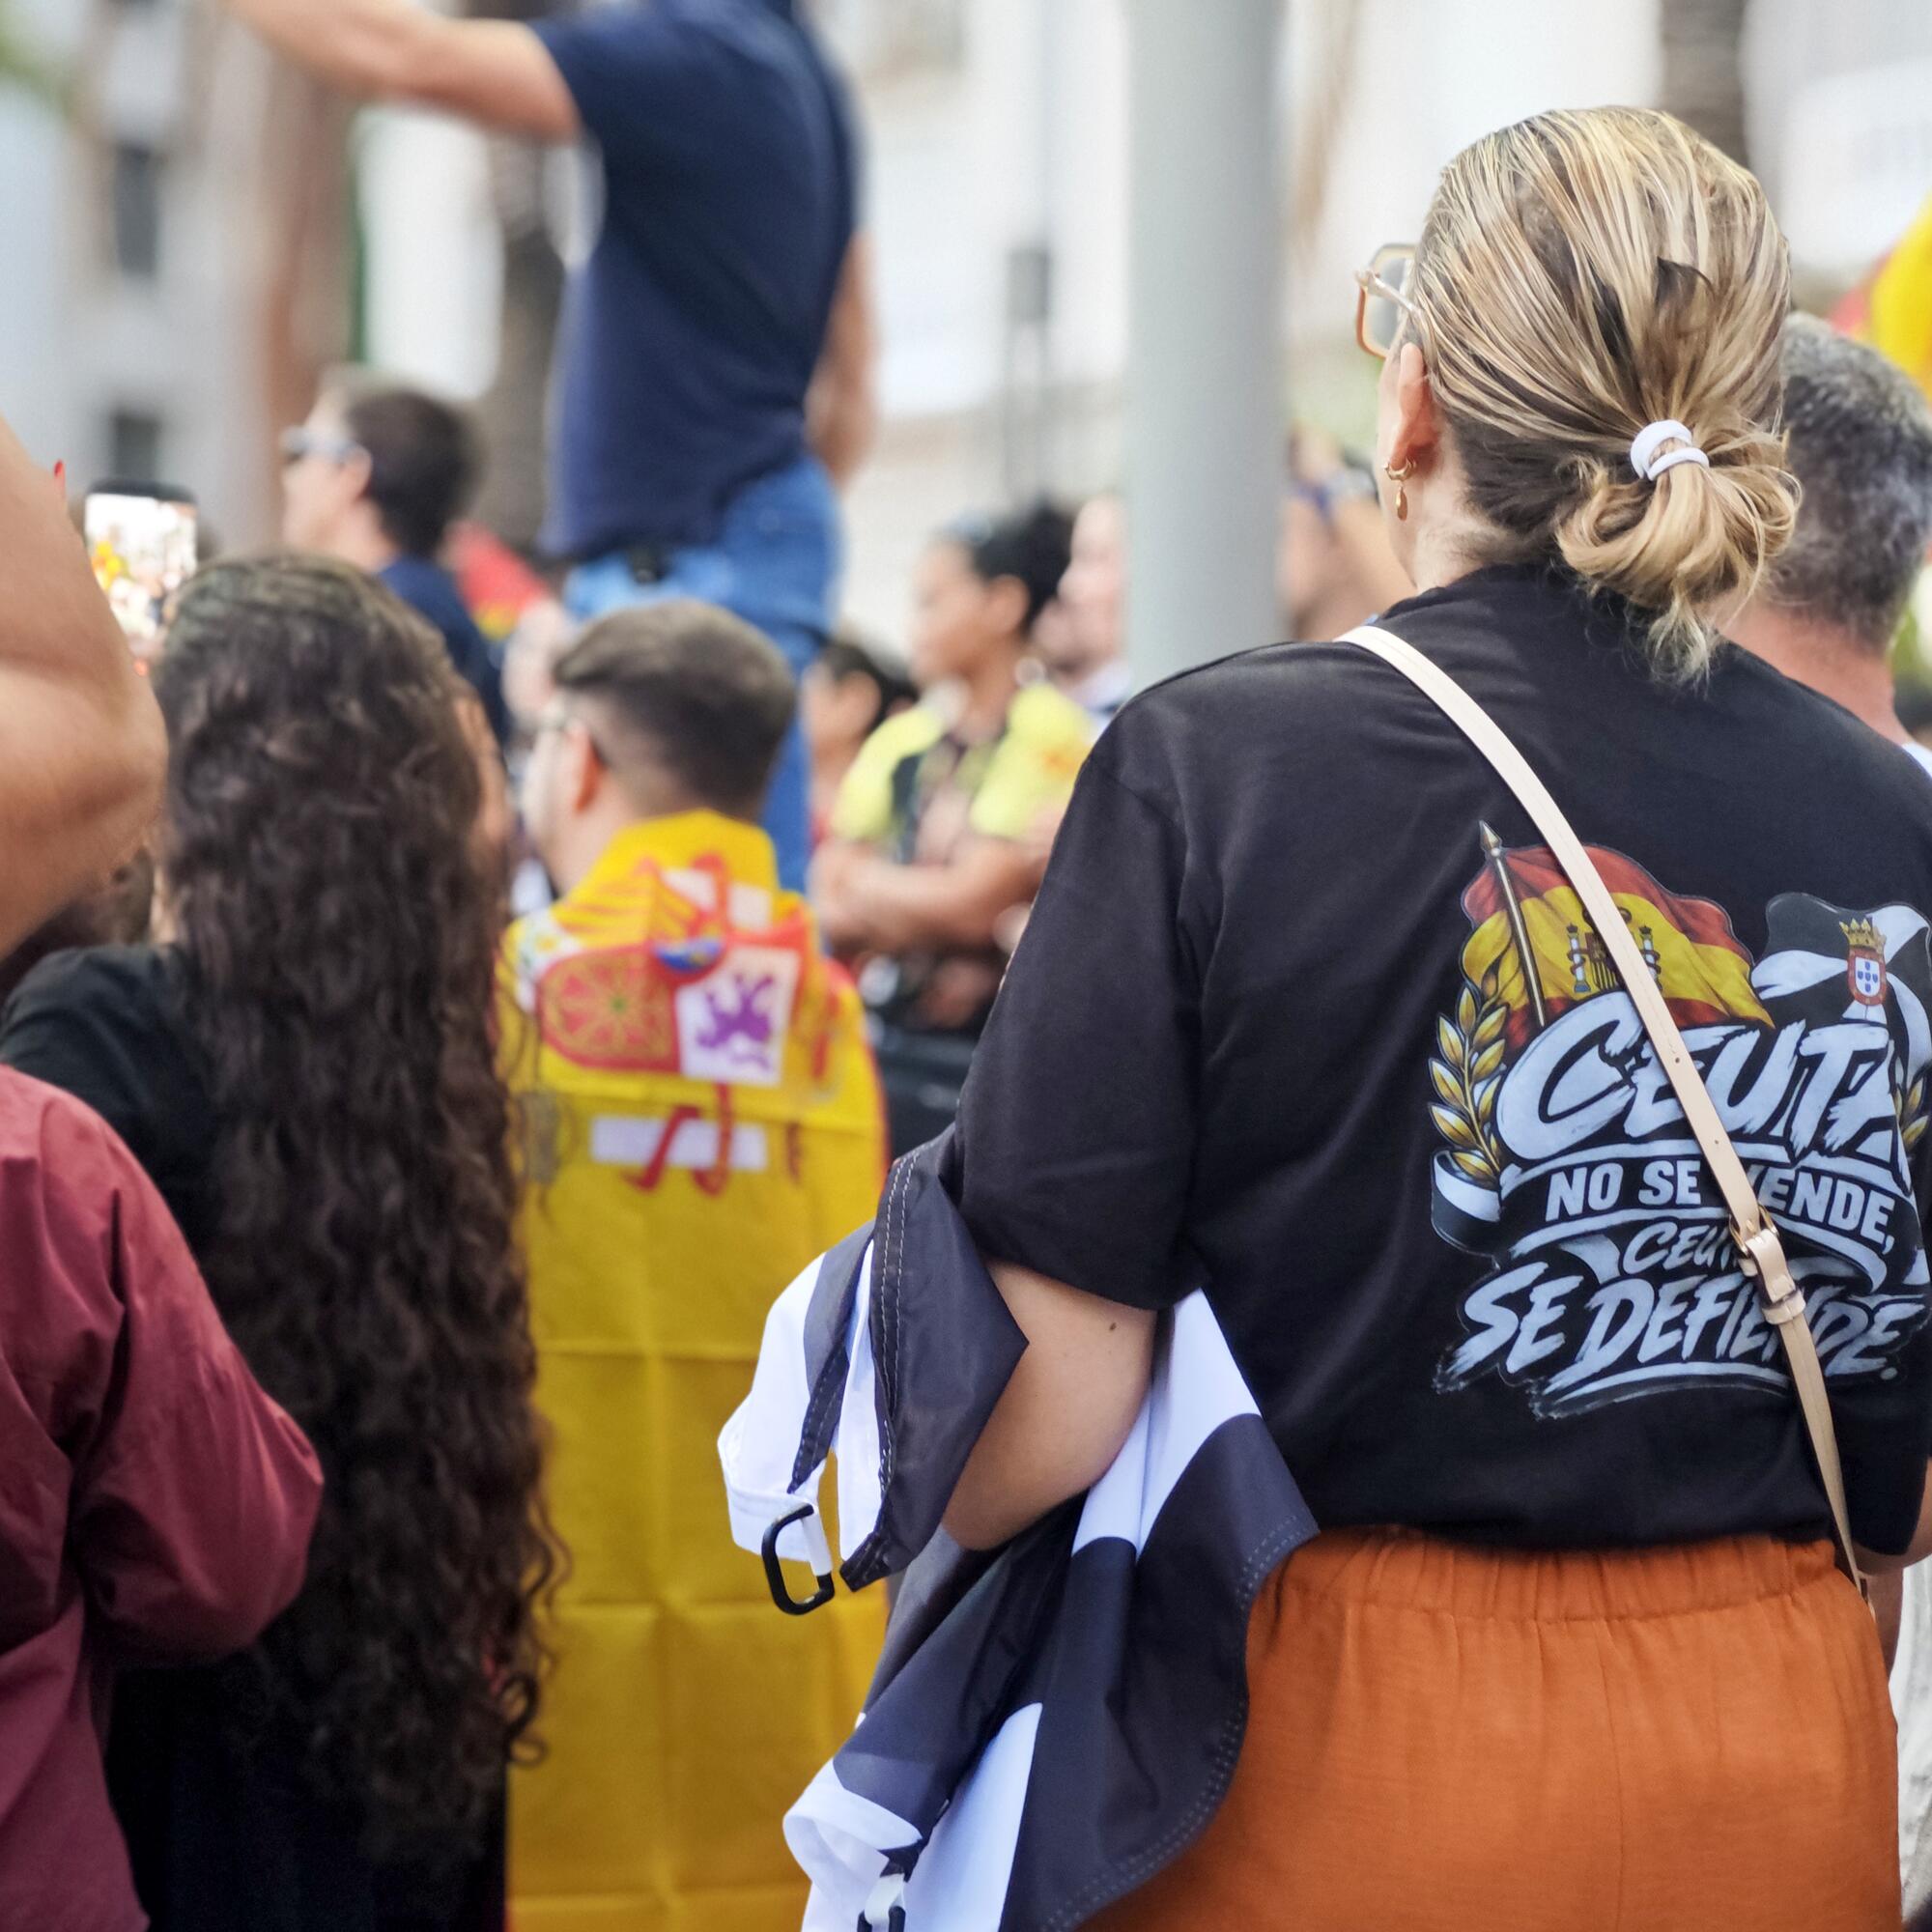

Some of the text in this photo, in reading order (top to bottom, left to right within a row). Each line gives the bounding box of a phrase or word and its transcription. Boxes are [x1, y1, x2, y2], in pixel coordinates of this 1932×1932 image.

[1496, 992, 1903, 1175] CEUTA
[1546, 1162, 1624, 1221] NO
[1638, 1160, 1701, 1206] SE
[1623, 1221, 1743, 1274] CEU
[1445, 1262, 1584, 1374] SE
